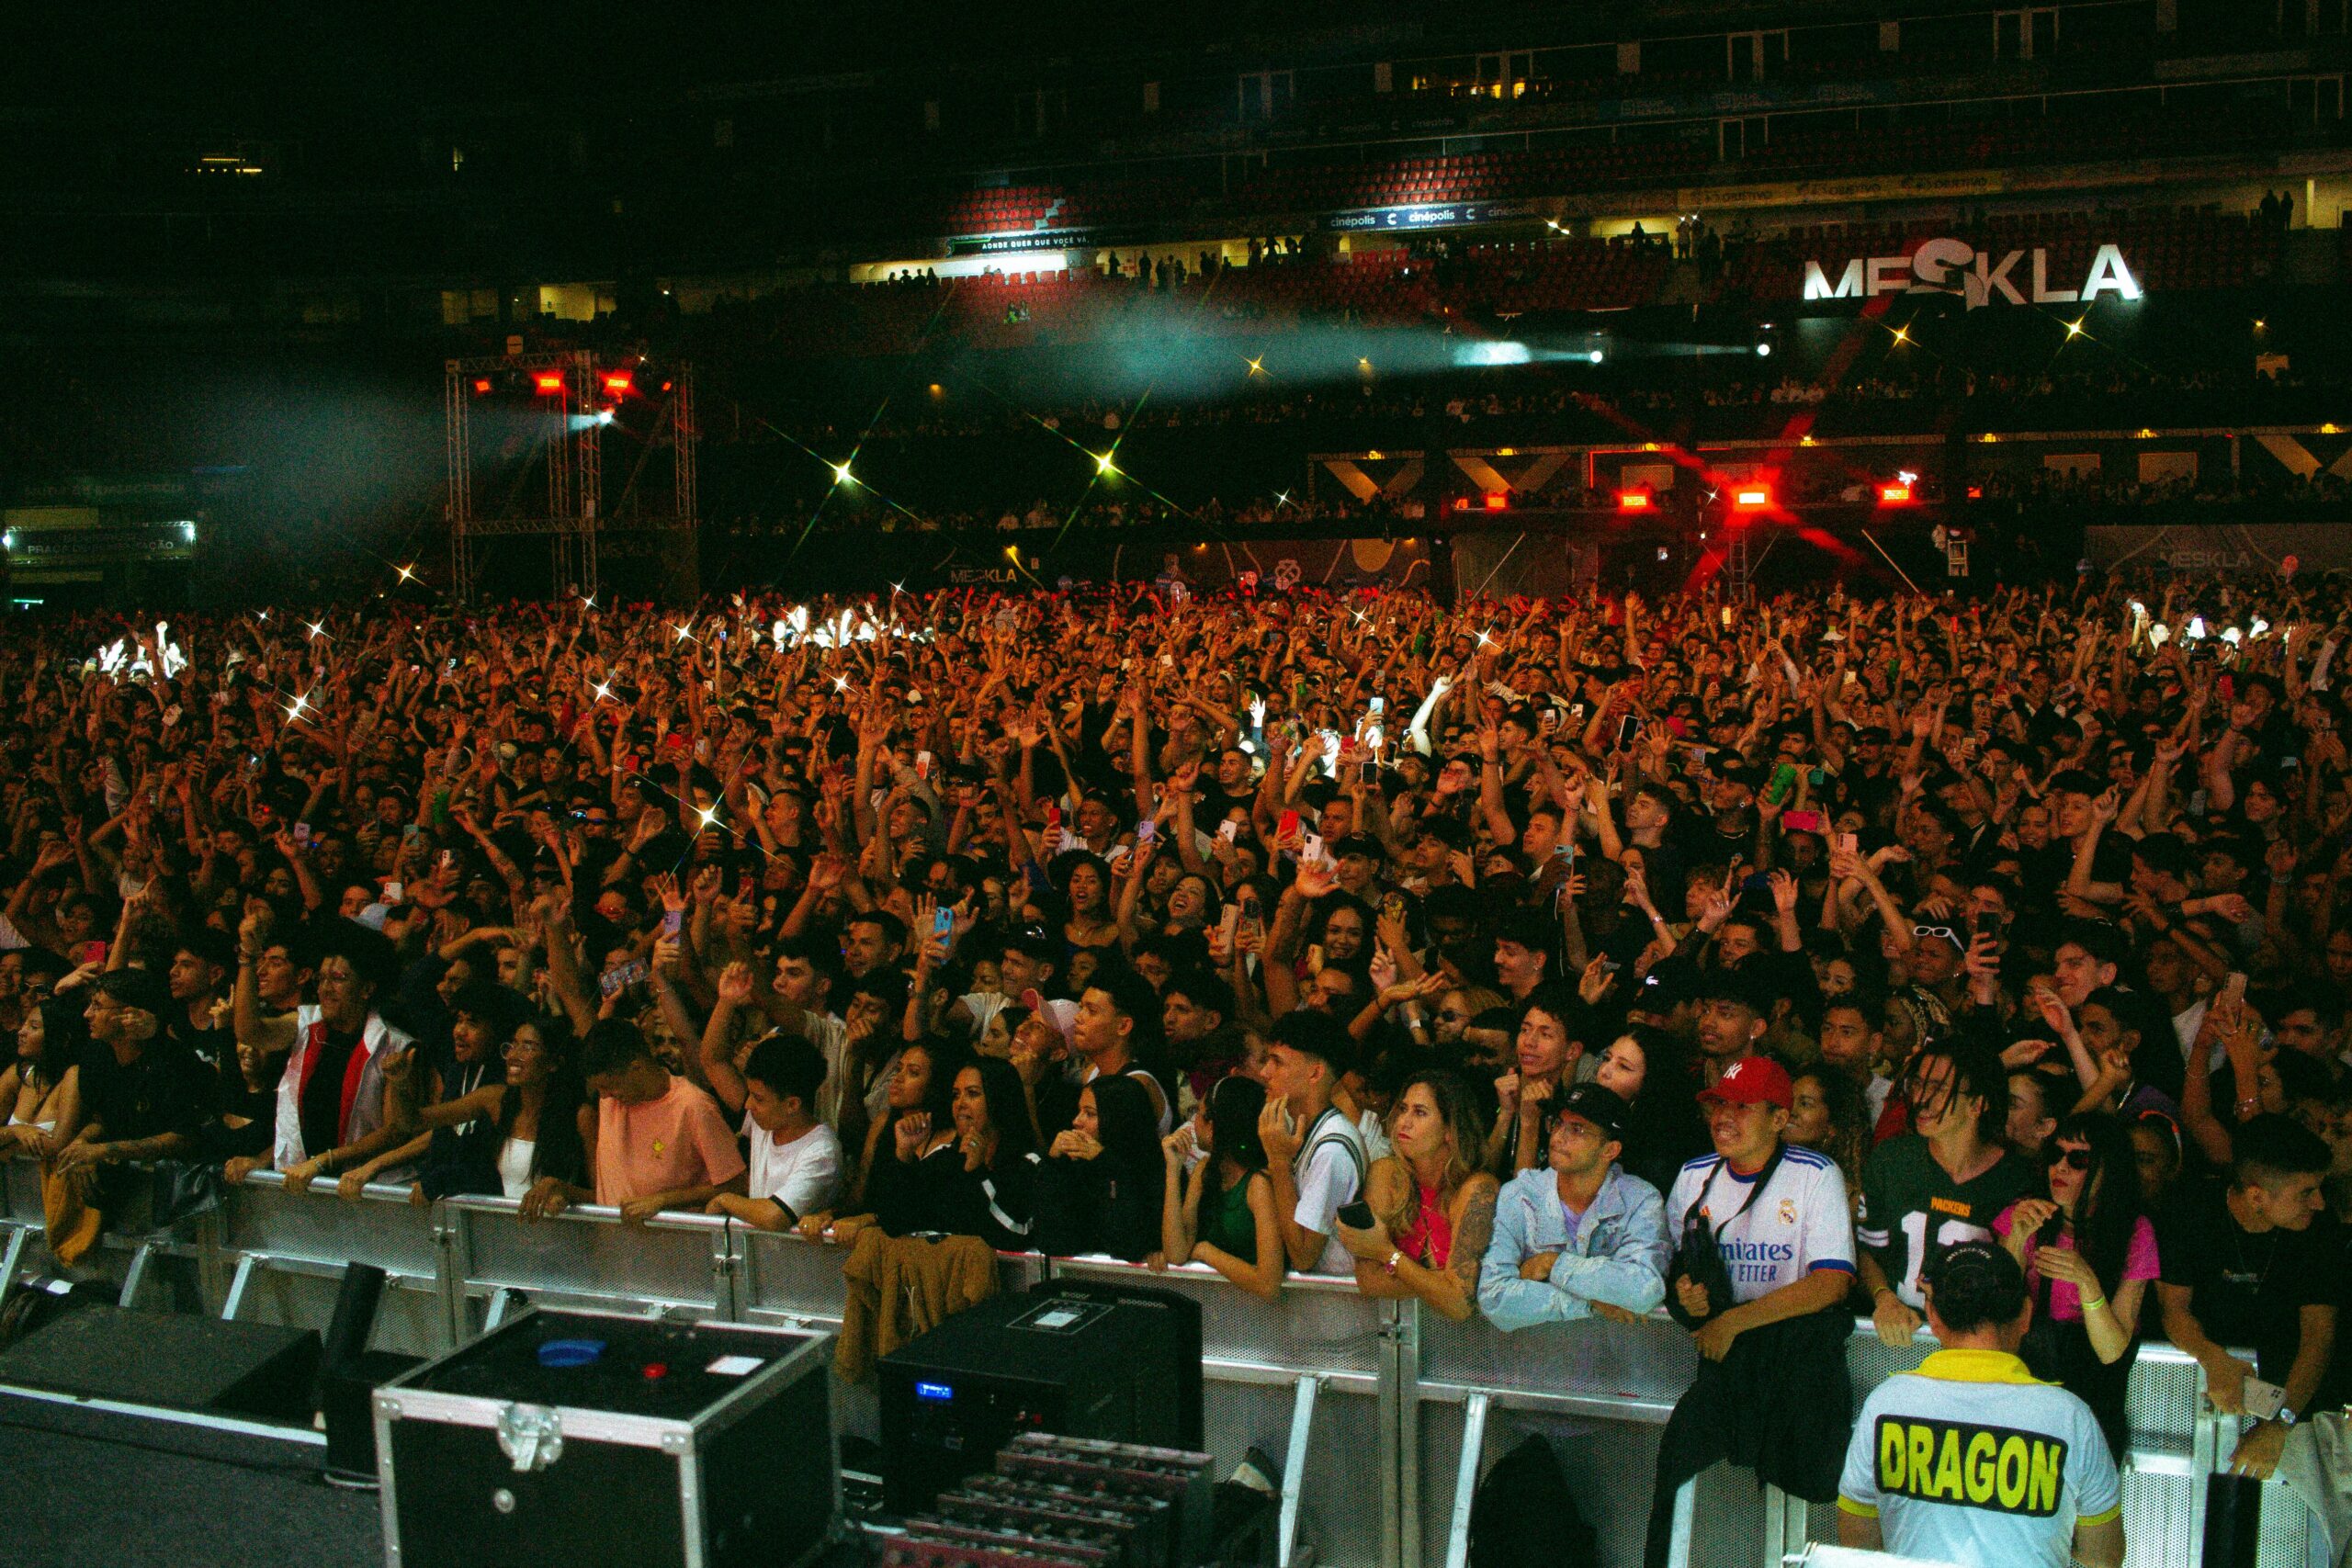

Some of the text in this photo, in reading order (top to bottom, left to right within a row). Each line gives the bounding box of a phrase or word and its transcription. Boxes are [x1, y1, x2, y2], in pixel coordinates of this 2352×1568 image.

[1330, 214, 1376, 228] cinépolis
[1408, 209, 1455, 223] cinépolis
[981, 241, 1009, 250] AONDE
[1011, 240, 1032, 248] QUER
[1053, 236, 1074, 244] VOCÊ
[1930, 1196, 1972, 1218] PACKERS
[1718, 1236, 1793, 1261] miates
[1737, 1263, 1778, 1282] ETTER
[1881, 1422, 2062, 1511] DRAGON
